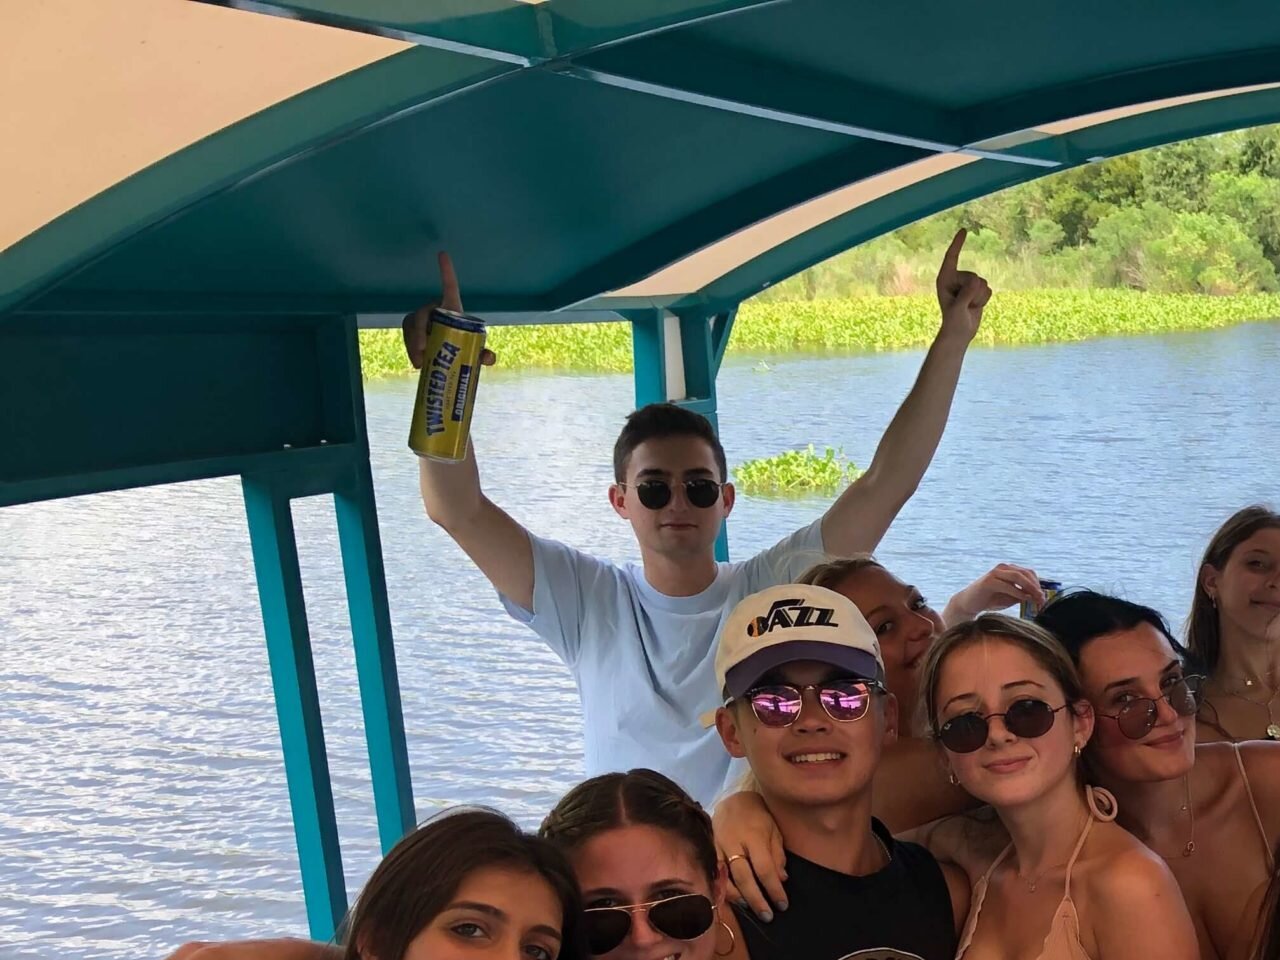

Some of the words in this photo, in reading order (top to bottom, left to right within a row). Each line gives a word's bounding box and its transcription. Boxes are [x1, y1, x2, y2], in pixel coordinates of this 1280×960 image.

[432, 341, 461, 370] TEA
[426, 369, 447, 437] TWISTED
[455, 373, 470, 420] ORIGINAL
[747, 599, 838, 637] JAZZ
